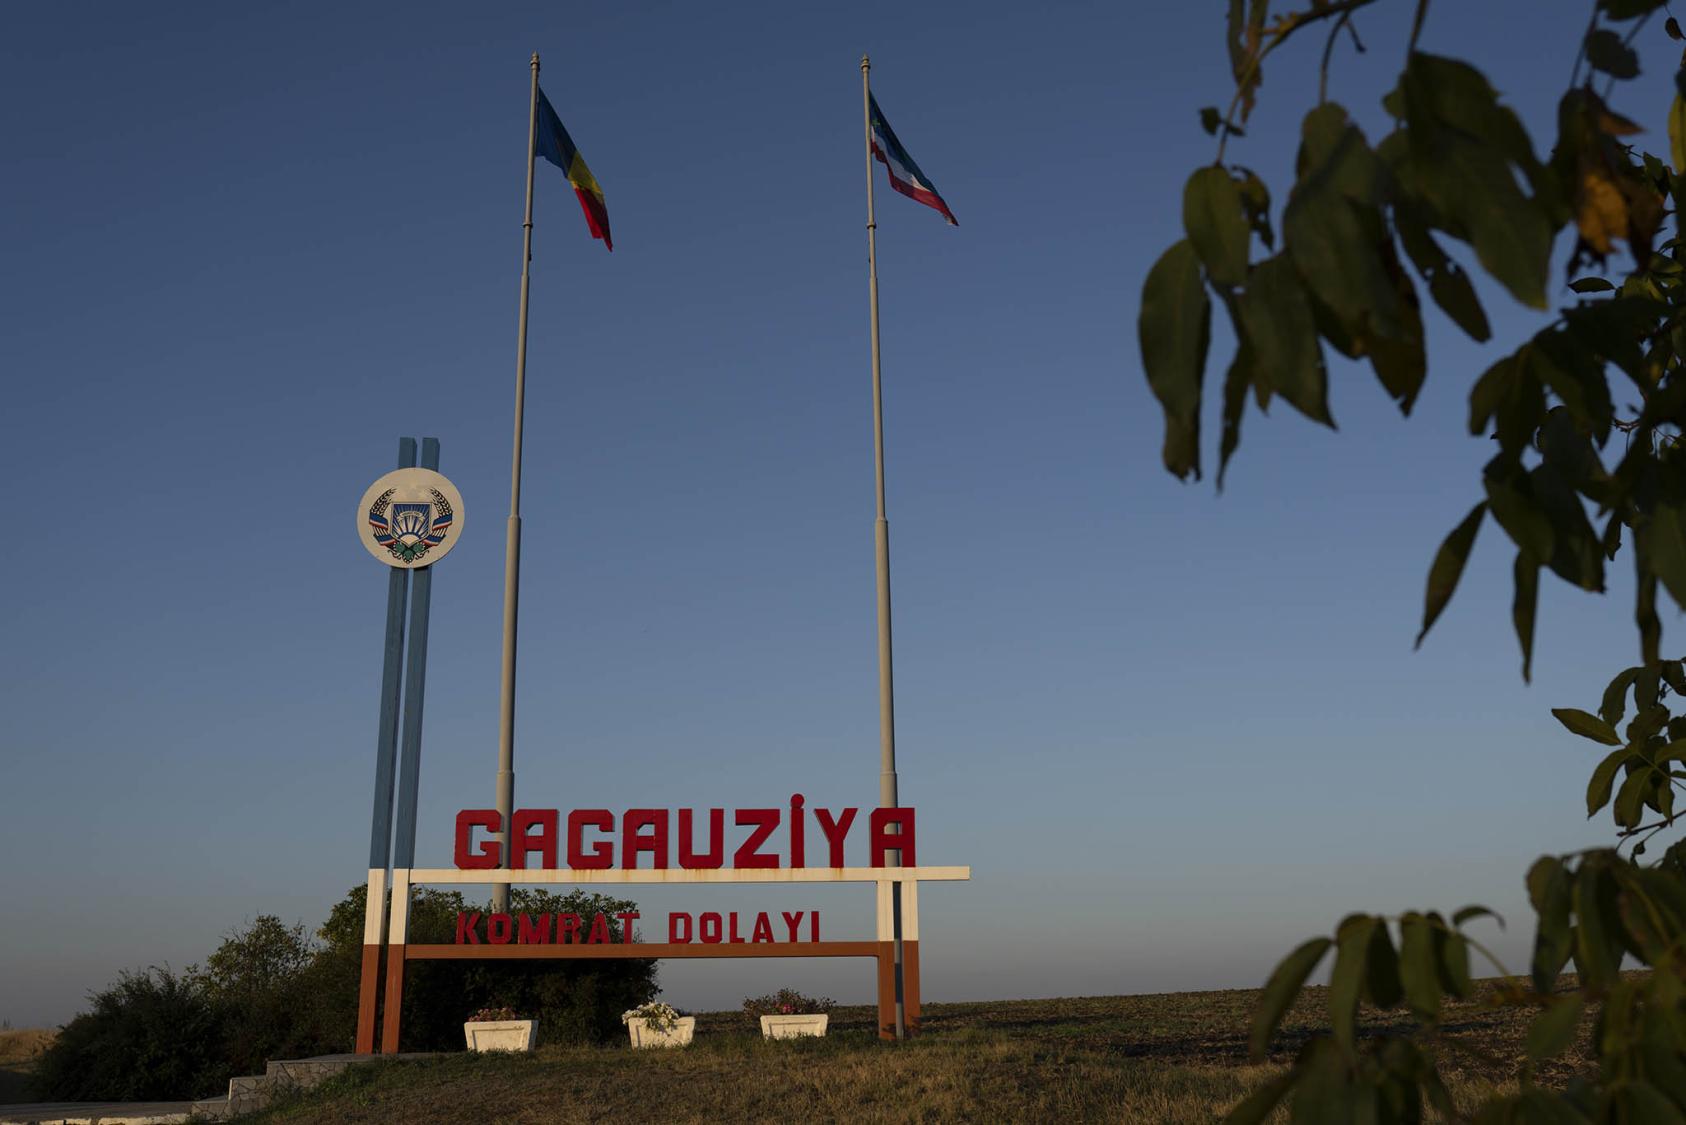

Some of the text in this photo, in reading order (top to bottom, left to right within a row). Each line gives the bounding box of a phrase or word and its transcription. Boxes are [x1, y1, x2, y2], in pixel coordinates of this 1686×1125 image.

[454, 794, 915, 870] GAGAUZİYA
[455, 911, 819, 944] KOMRAT DOLAYI
